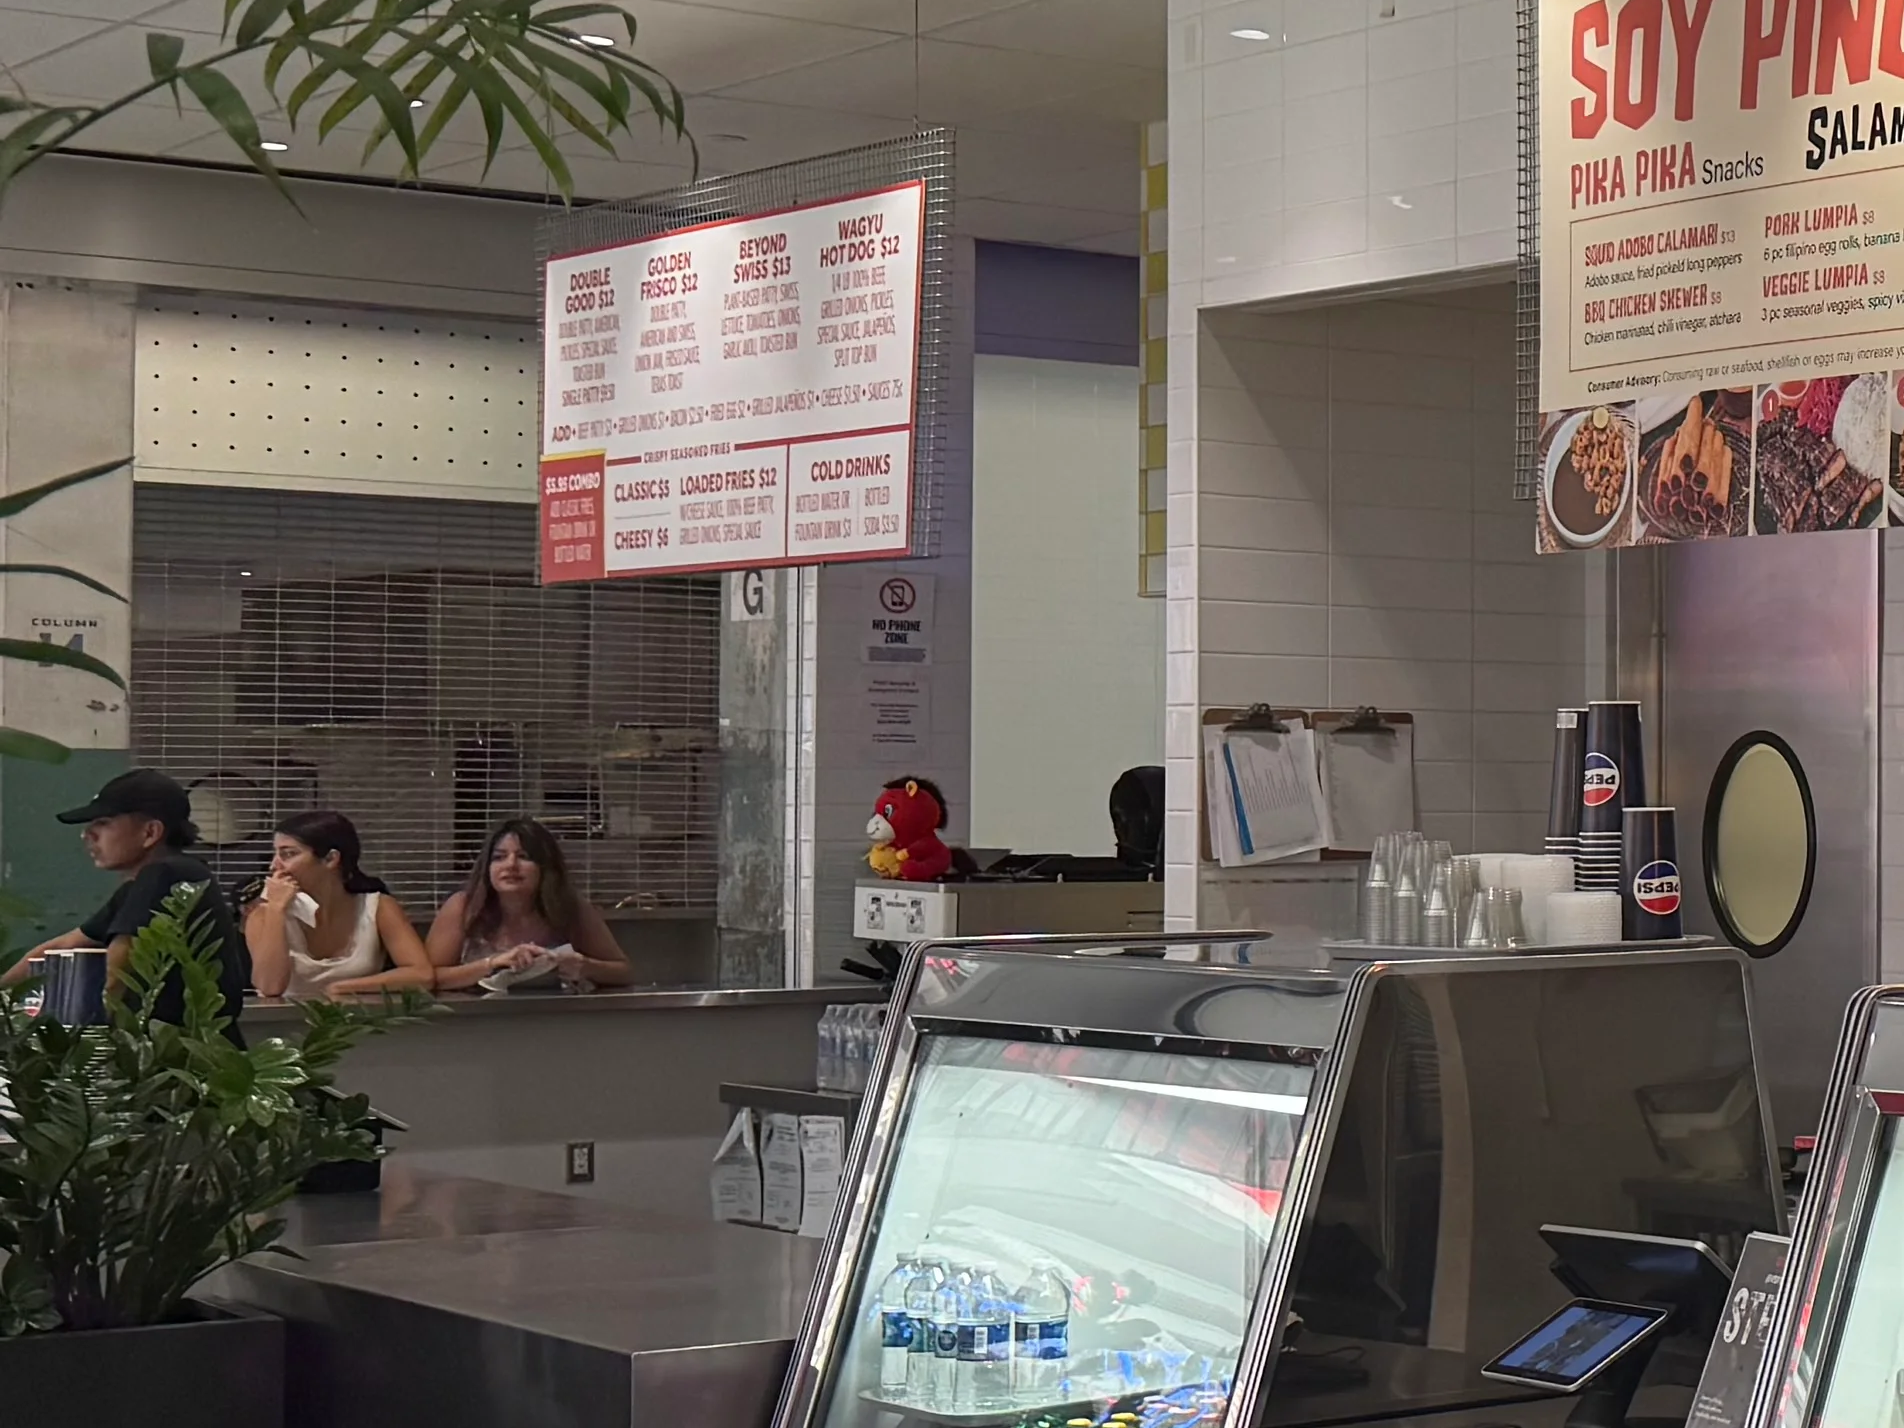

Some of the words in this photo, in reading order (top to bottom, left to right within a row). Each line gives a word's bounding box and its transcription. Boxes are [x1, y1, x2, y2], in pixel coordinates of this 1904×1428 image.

[1570, 155, 1626, 210] PIKA
[1636, 141, 1696, 197] PIKA
[1701, 150, 1764, 185] Snacks
[838, 213, 884, 241] WAGYU
[739, 233, 787, 260] BEYOND
[820, 243, 846, 268] HOT
[847, 238, 876, 263] DOG
[880, 234, 900, 259] $12
[647, 251, 692, 277] GOLDEN
[733, 258, 769, 284] SWISS
[772, 255, 791, 279] $13
[570, 266, 611, 292] DOUBLE
[640, 276, 677, 301] FRISCO
[681, 272, 698, 295] $12
[1762, 270, 1810, 298] VEGGIE
[1814, 262, 1869, 291] LUMPIA
[1768, 397, 1773, 413] 1
[680, 472, 723, 496] LOADED
[725, 468, 756, 491] FRIES
[758, 467, 777, 490] $12
[810, 459, 844, 483] COLD
[845, 453, 891, 479] DRINKS
[614, 479, 657, 503] CLASSIC
[658, 478, 670, 500] $5
[614, 529, 654, 551] CHEESY
[657, 527, 669, 549] $6
[743, 569, 764, 616] G
[31, 617, 98, 628] COLUMN
[872, 619, 887, 631] NO
